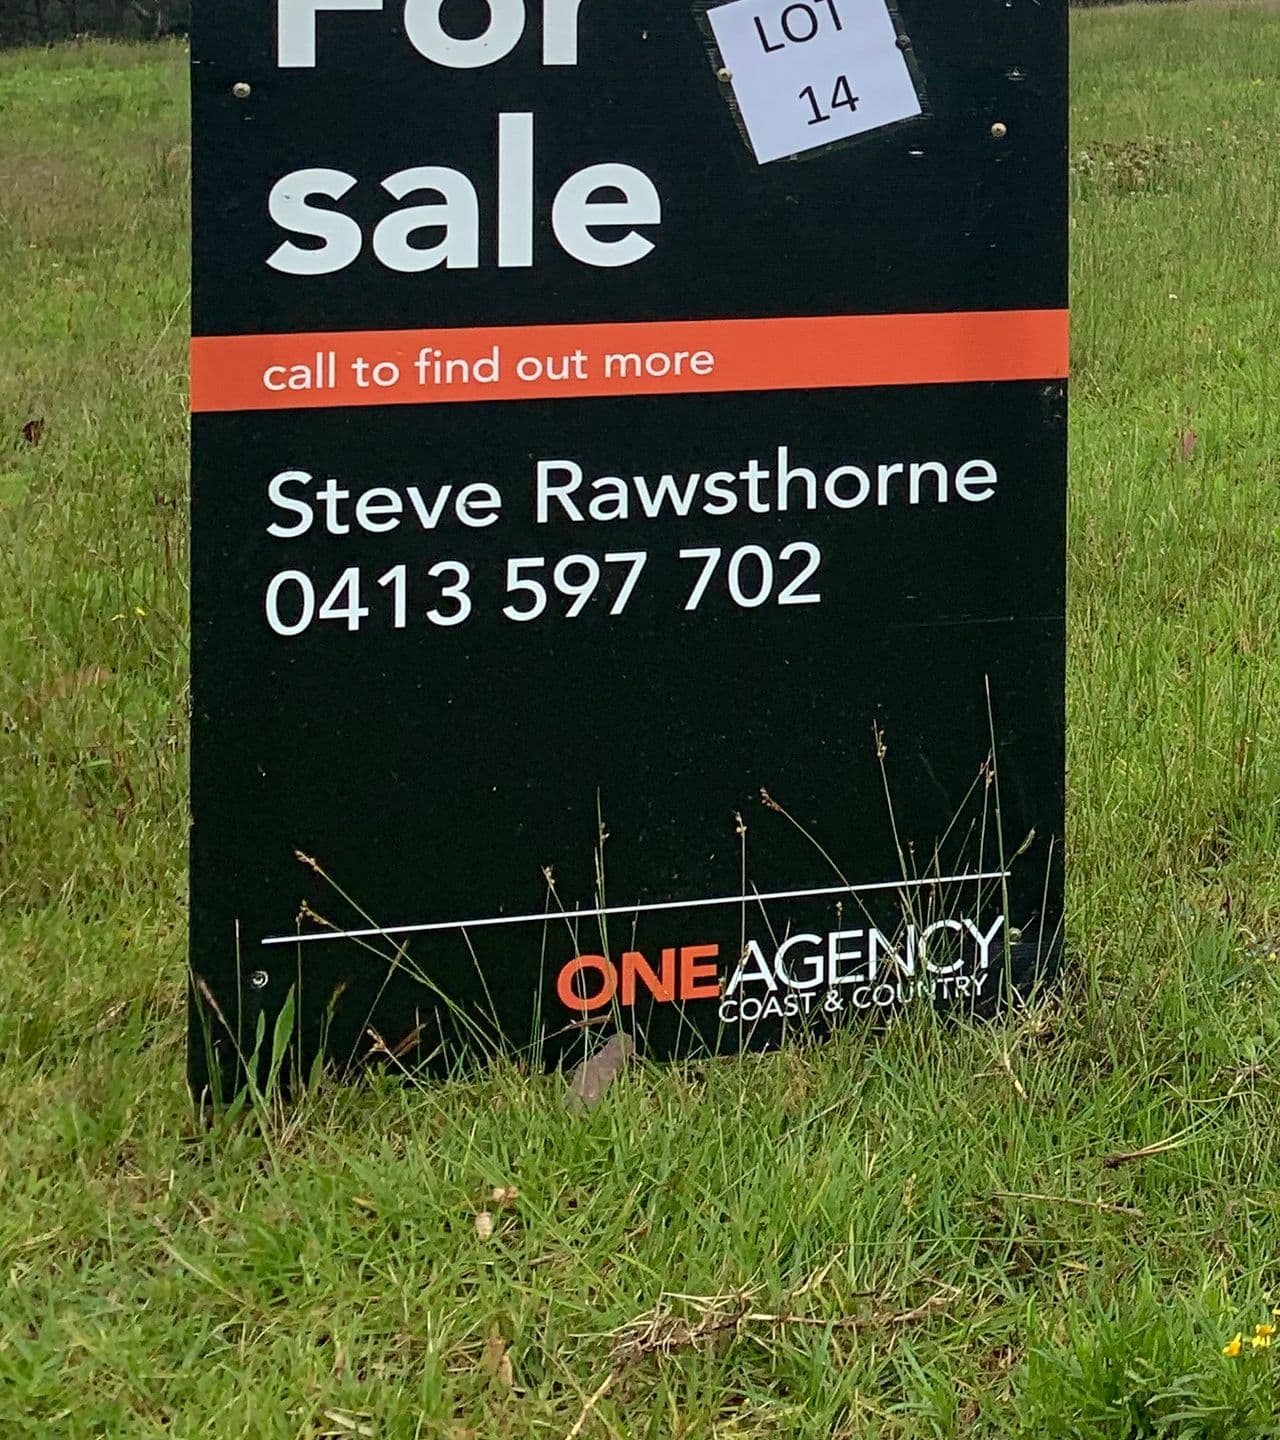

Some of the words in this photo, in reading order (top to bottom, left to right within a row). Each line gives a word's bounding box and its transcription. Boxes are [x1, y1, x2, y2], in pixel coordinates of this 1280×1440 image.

[798, 75, 860, 126] 14
[265, 111, 661, 275] sale
[262, 351, 336, 391] call
[351, 357, 400, 388] to
[414, 345, 500, 385] find
[516, 349, 588, 381] out
[604, 350, 715, 378] more
[266, 470, 502, 538] Steve
[536, 445, 998, 524] Rawsthorne
[265, 560, 472, 636] 0413
[502, 551, 647, 622] 597
[679, 541, 822, 611] 702
[718, 992, 812, 1023] COAST
[823, 991, 844, 1012] &
[851, 973, 989, 1009] COUNTRY
